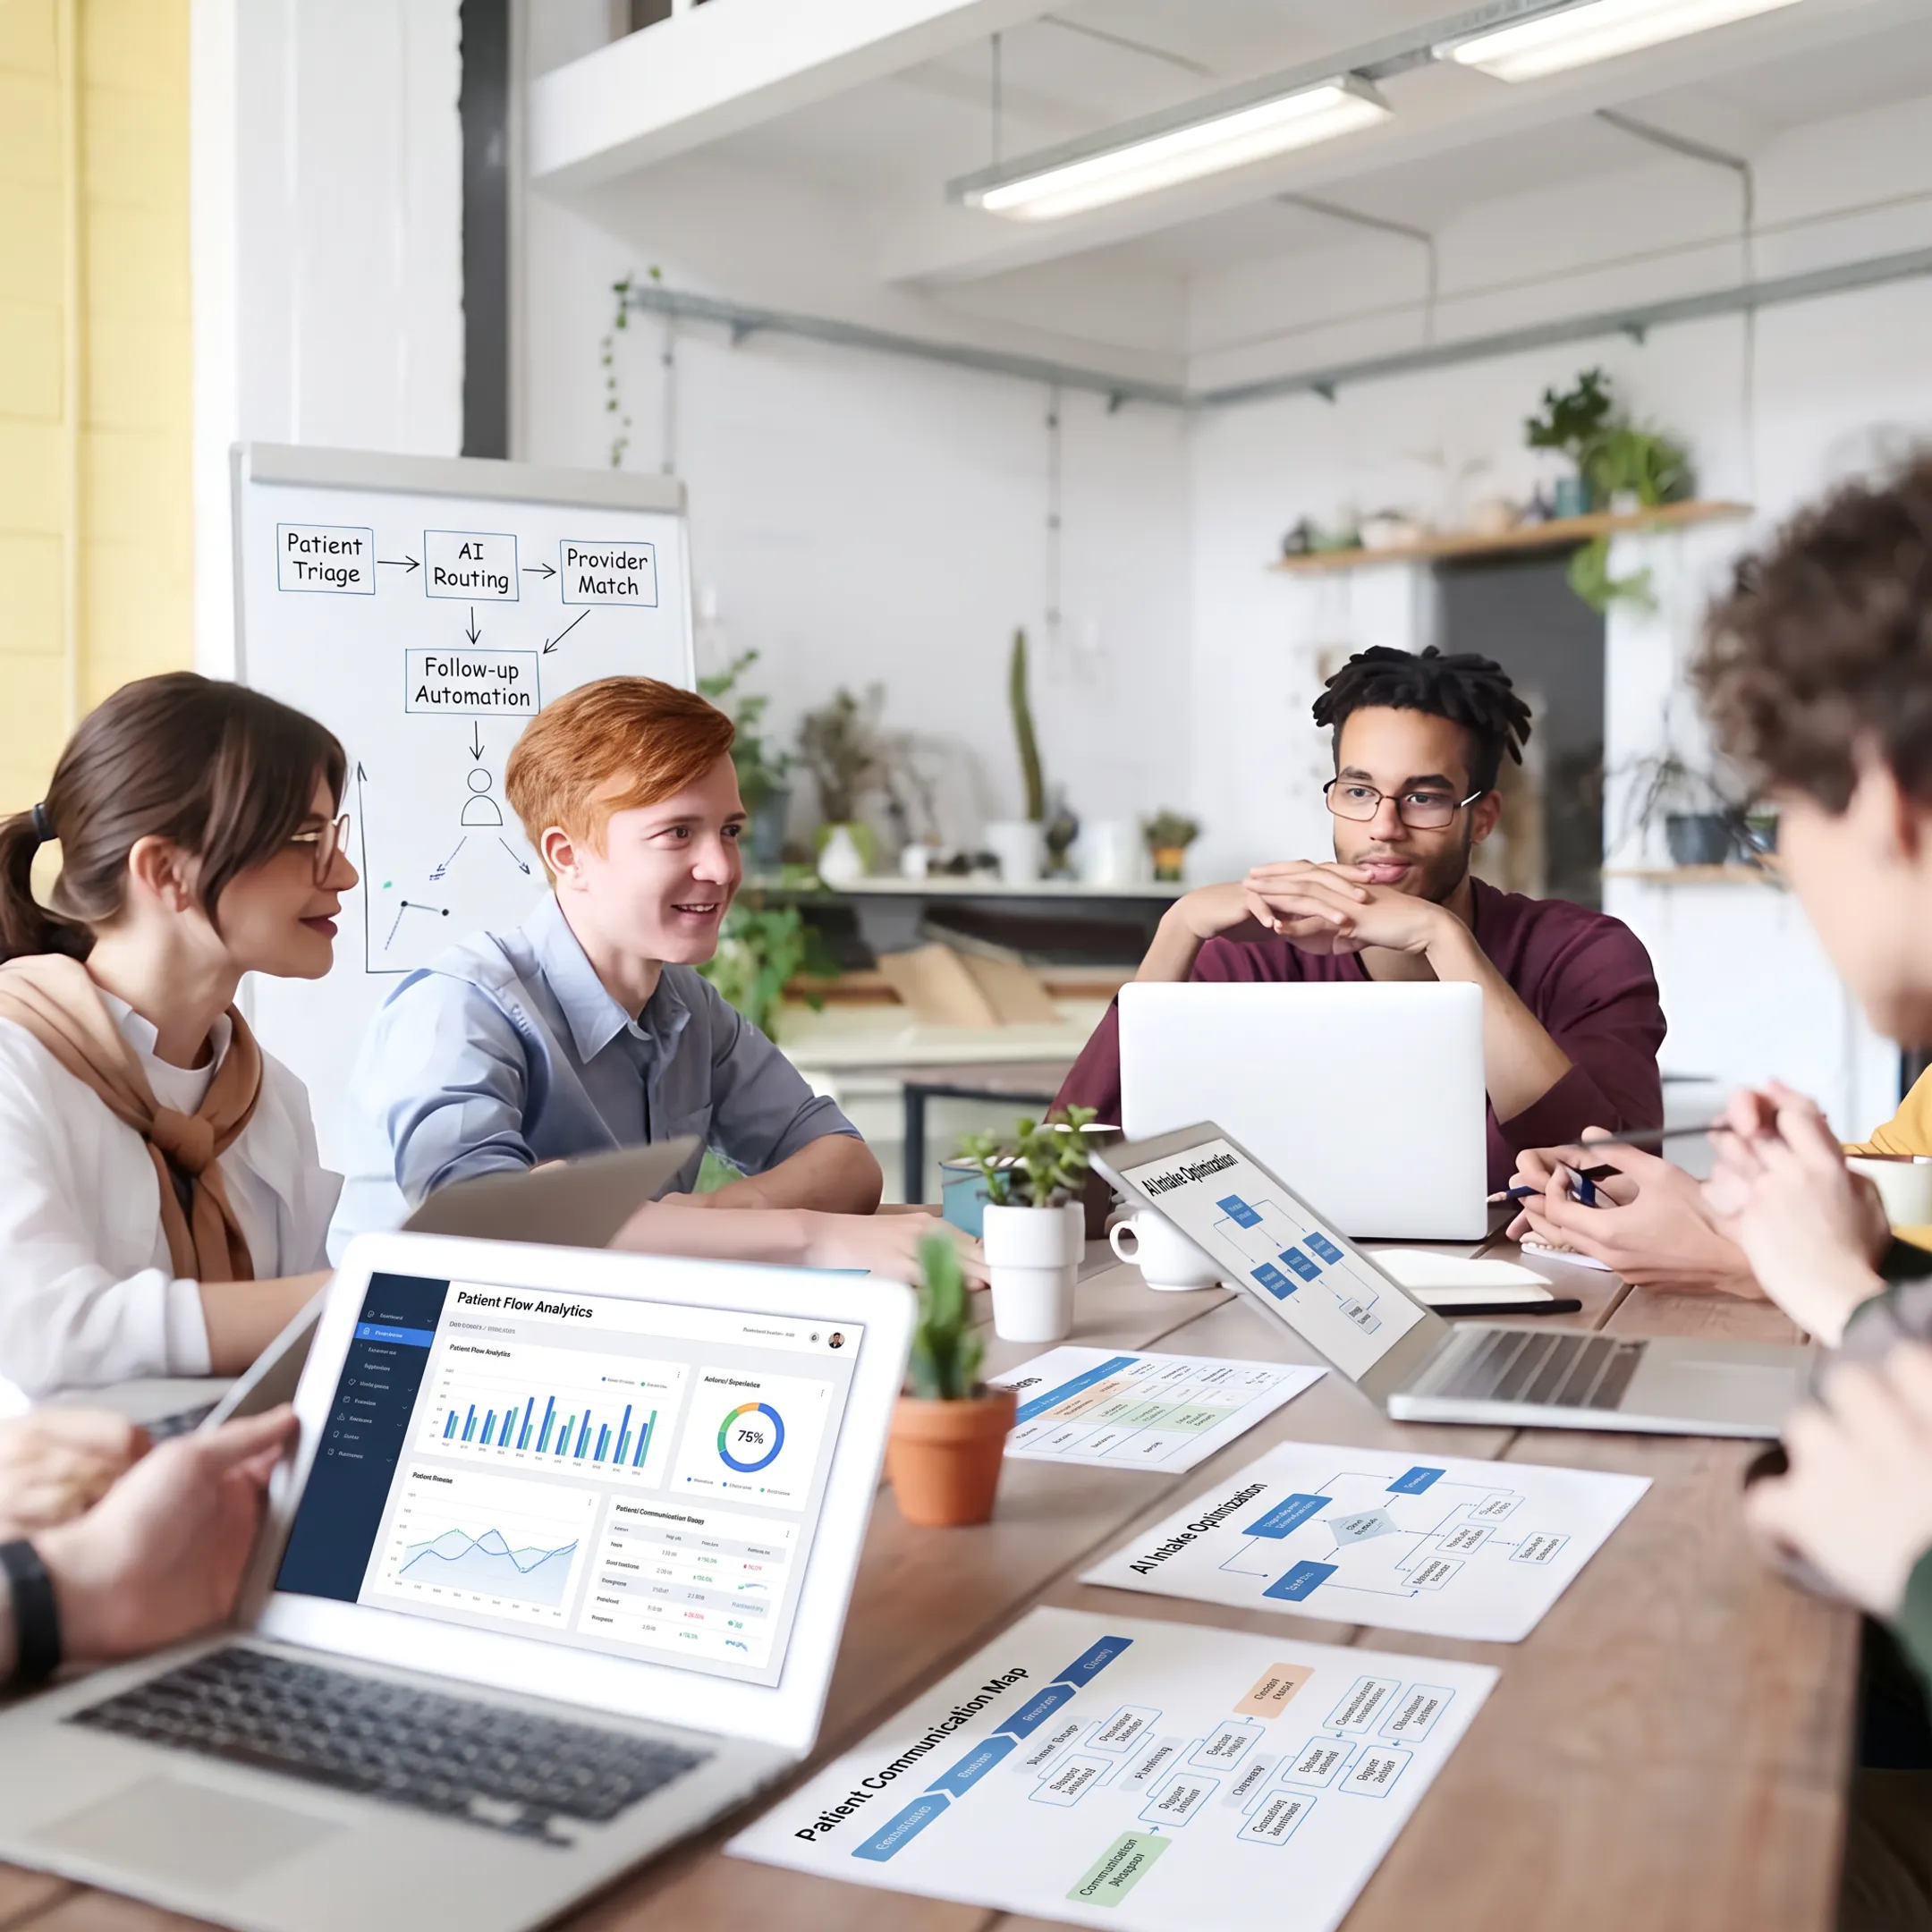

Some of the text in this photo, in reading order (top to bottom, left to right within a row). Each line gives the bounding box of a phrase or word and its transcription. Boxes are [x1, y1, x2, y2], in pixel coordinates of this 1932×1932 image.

[287, 533, 363, 556] Patient
[458, 542, 485, 561] AI
[566, 547, 648, 572] Provider
[292, 561, 361, 588] Triage
[434, 567, 510, 594] Routing
[578, 575, 639, 597] Match
[425, 657, 520, 684] Follow-up
[414, 685, 531, 708] Automation
[1141, 1179, 1159, 1197] AI
[457, 1291, 593, 1318] Patient Flow Analytics
[449, 1343, 470, 1353] Patient
[737, 1429, 764, 1445] 75%
[1130, 1561, 1158, 1575] AI
[1144, 1532, 1198, 1562] Intake
[794, 1790, 873, 1843] Patient
[861, 1693, 994, 1790] Communication
[981, 1665, 1030, 1694] Map
